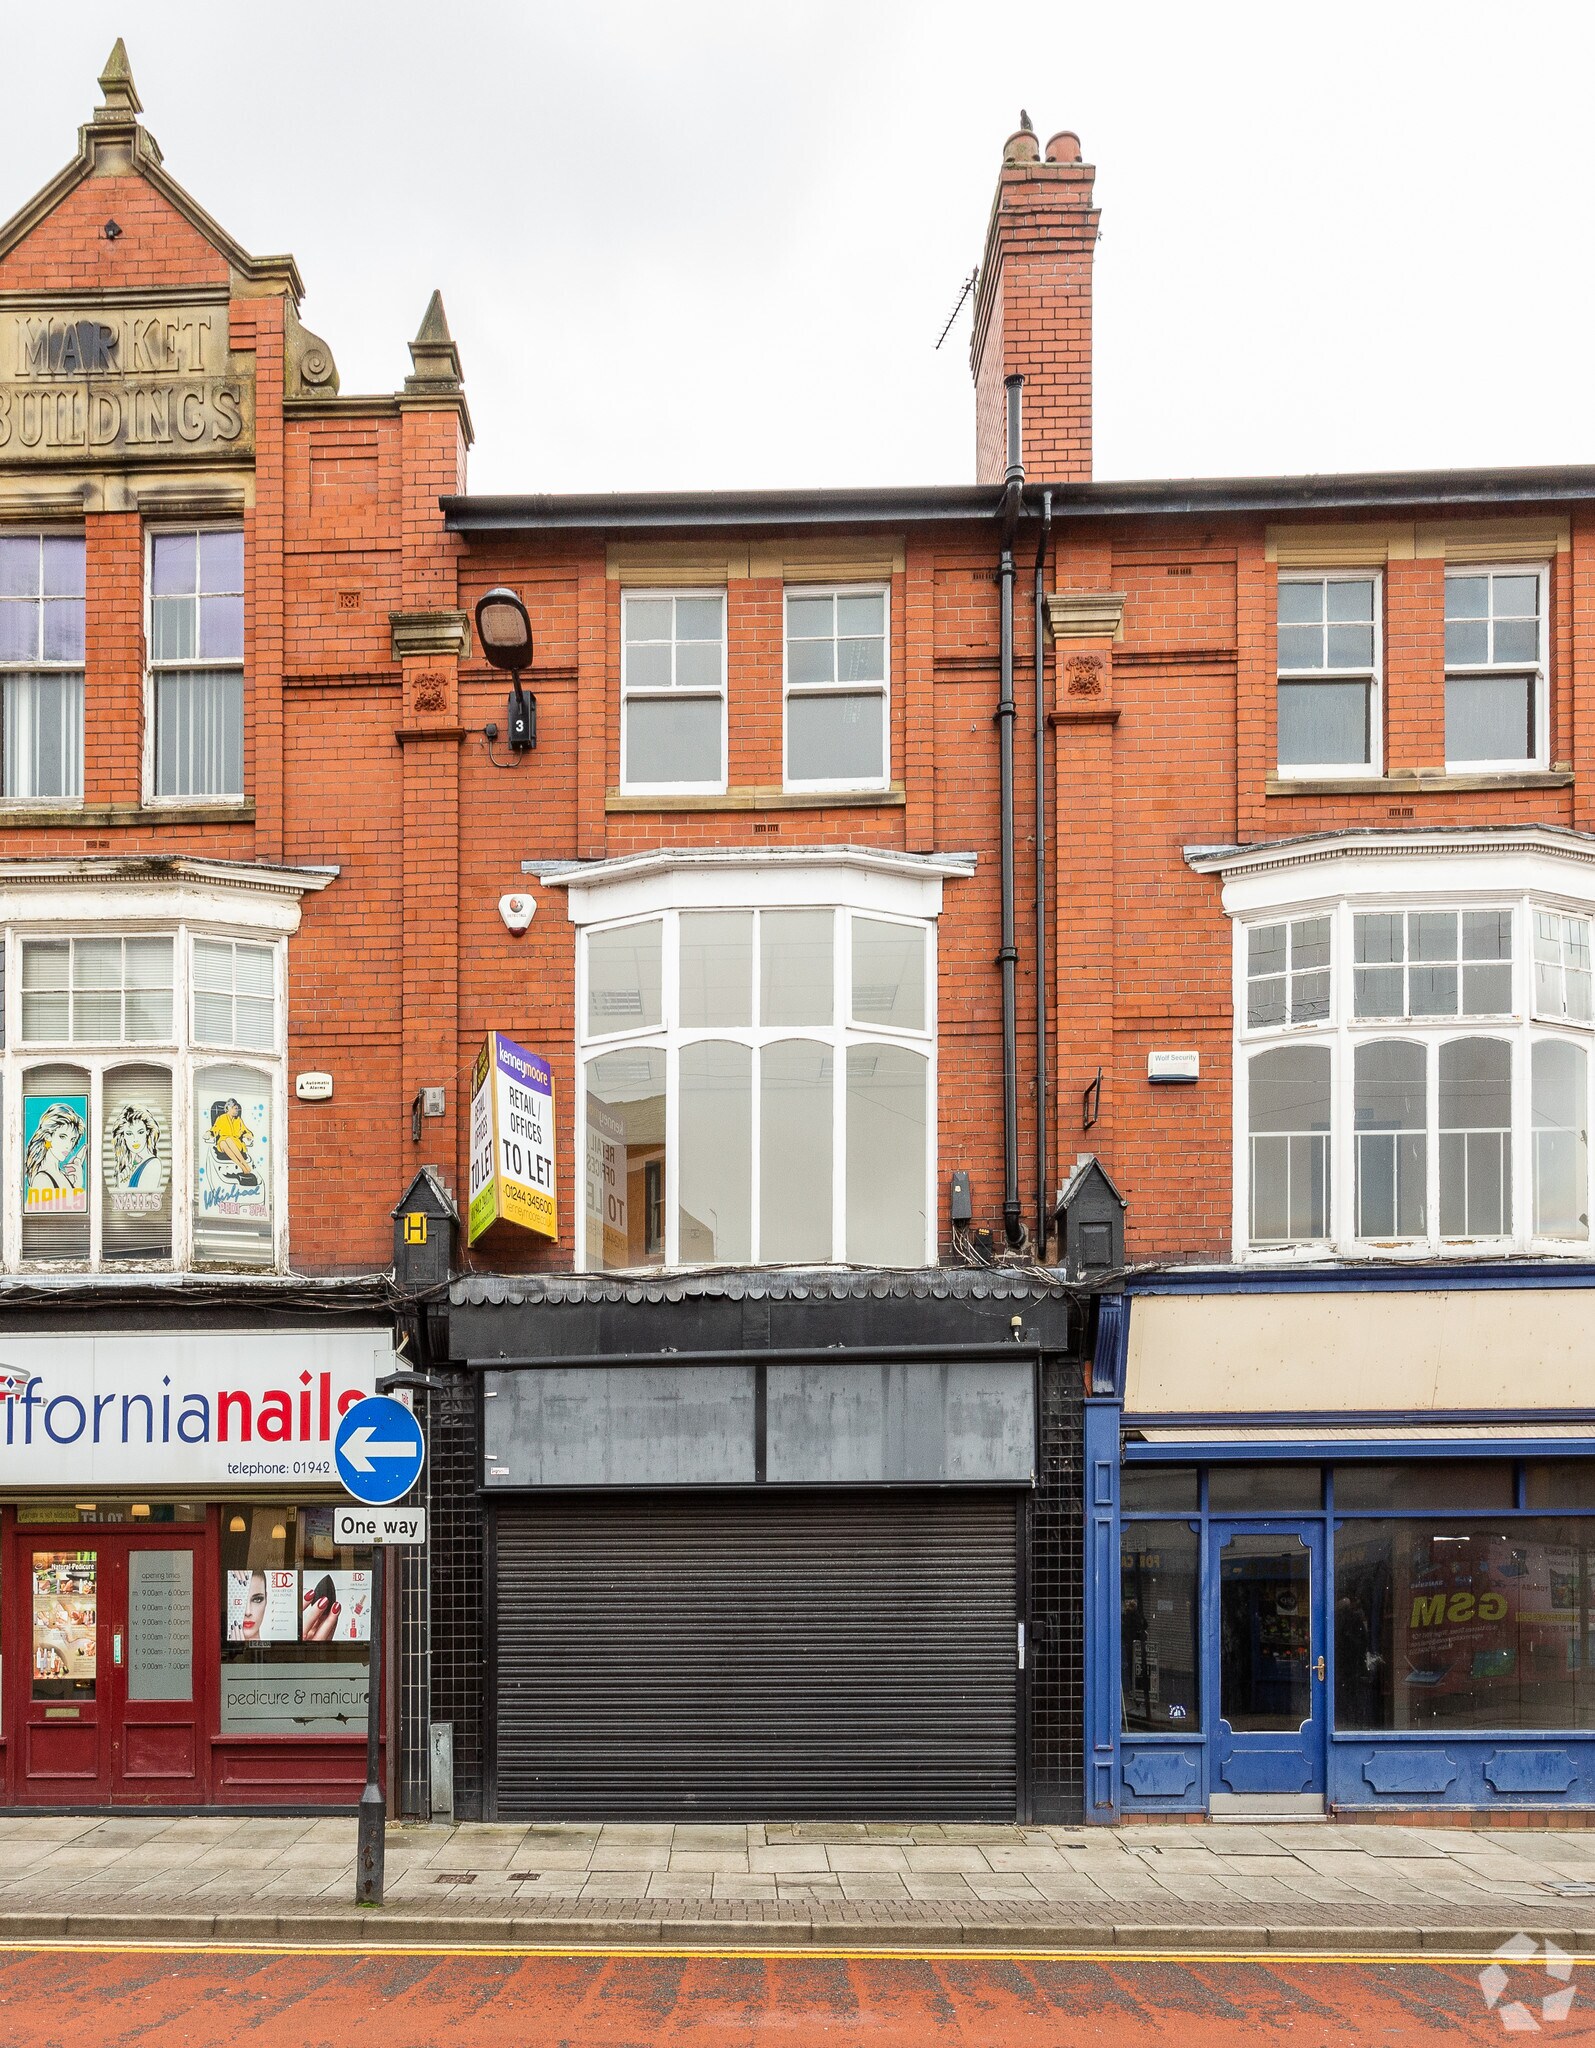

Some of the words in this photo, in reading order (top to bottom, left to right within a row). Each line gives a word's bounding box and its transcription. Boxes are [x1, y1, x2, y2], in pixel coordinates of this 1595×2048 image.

[15, 316, 211, 376] MARKET
[515, 719, 524, 732] 3
[499, 1041, 548, 1086] kenneymoore
[509, 1086, 536, 1117] RETAIL
[510, 1112, 542, 1145] OFFICES
[471, 1158, 480, 1194] TO
[481, 1139, 493, 1182] LET
[502, 1138, 522, 1175] TO
[527, 1150, 552, 1188] LET
[28, 1187, 85, 1211] NAILS
[110, 1193, 163, 1211] NAILS
[203, 1184, 260, 1210] Whirlpool
[505, 1184, 527, 1203] 01244
[527, 1192, 553, 1215] 345600
[248, 1204, 268, 1217] SPA
[407, 1216, 424, 1241] H
[227, 1462, 289, 1477] telephone:
[293, 1462, 330, 1474] 01942
[341, 1516, 377, 1534] One
[384, 1520, 419, 1537] way
[276, 1572, 293, 1588] DC
[227, 1689, 290, 1708] pedicure
[293, 1689, 306, 1704] &
